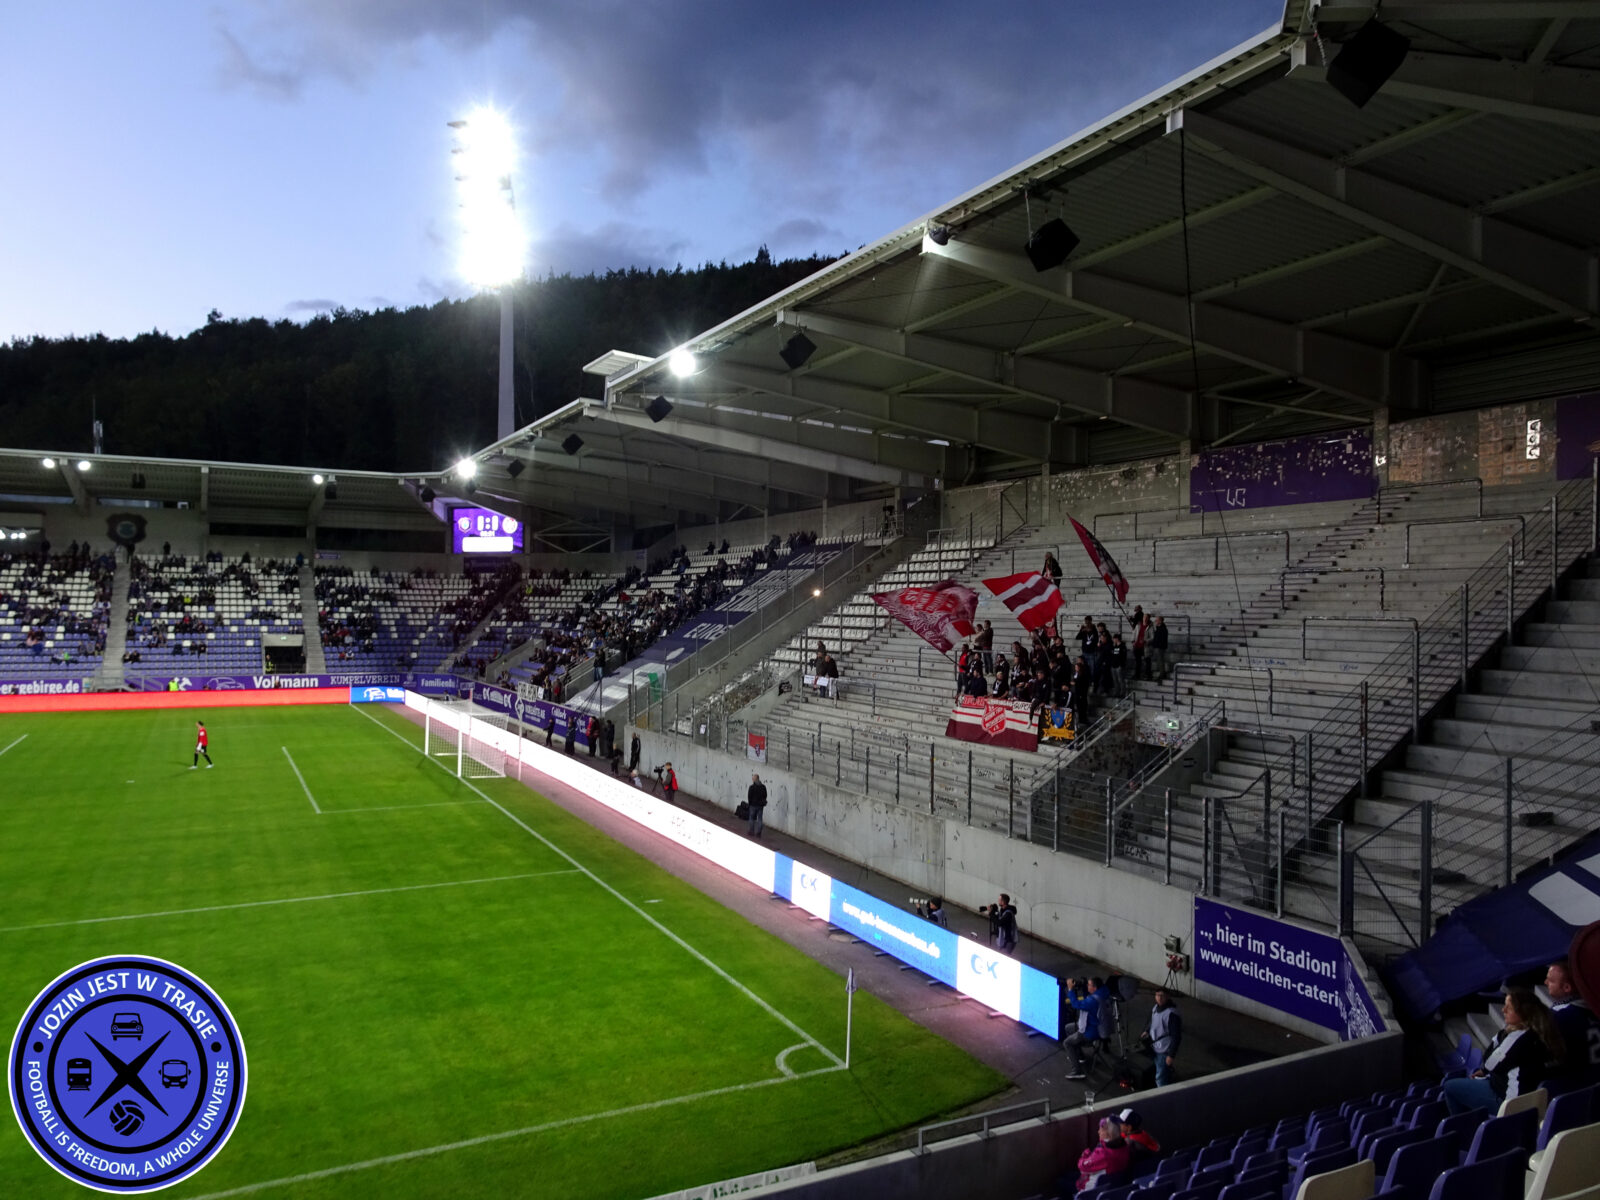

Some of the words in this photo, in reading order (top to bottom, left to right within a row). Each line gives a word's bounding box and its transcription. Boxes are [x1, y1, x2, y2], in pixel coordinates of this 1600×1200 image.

[0, 680, 80, 694] -ergebirge.de
[330, 675, 400, 685] KUMPELVEREIN
[1216, 924, 1244, 948] hier
[1247, 933, 1266, 956] im
[1269, 941, 1337, 979] Stadion!
